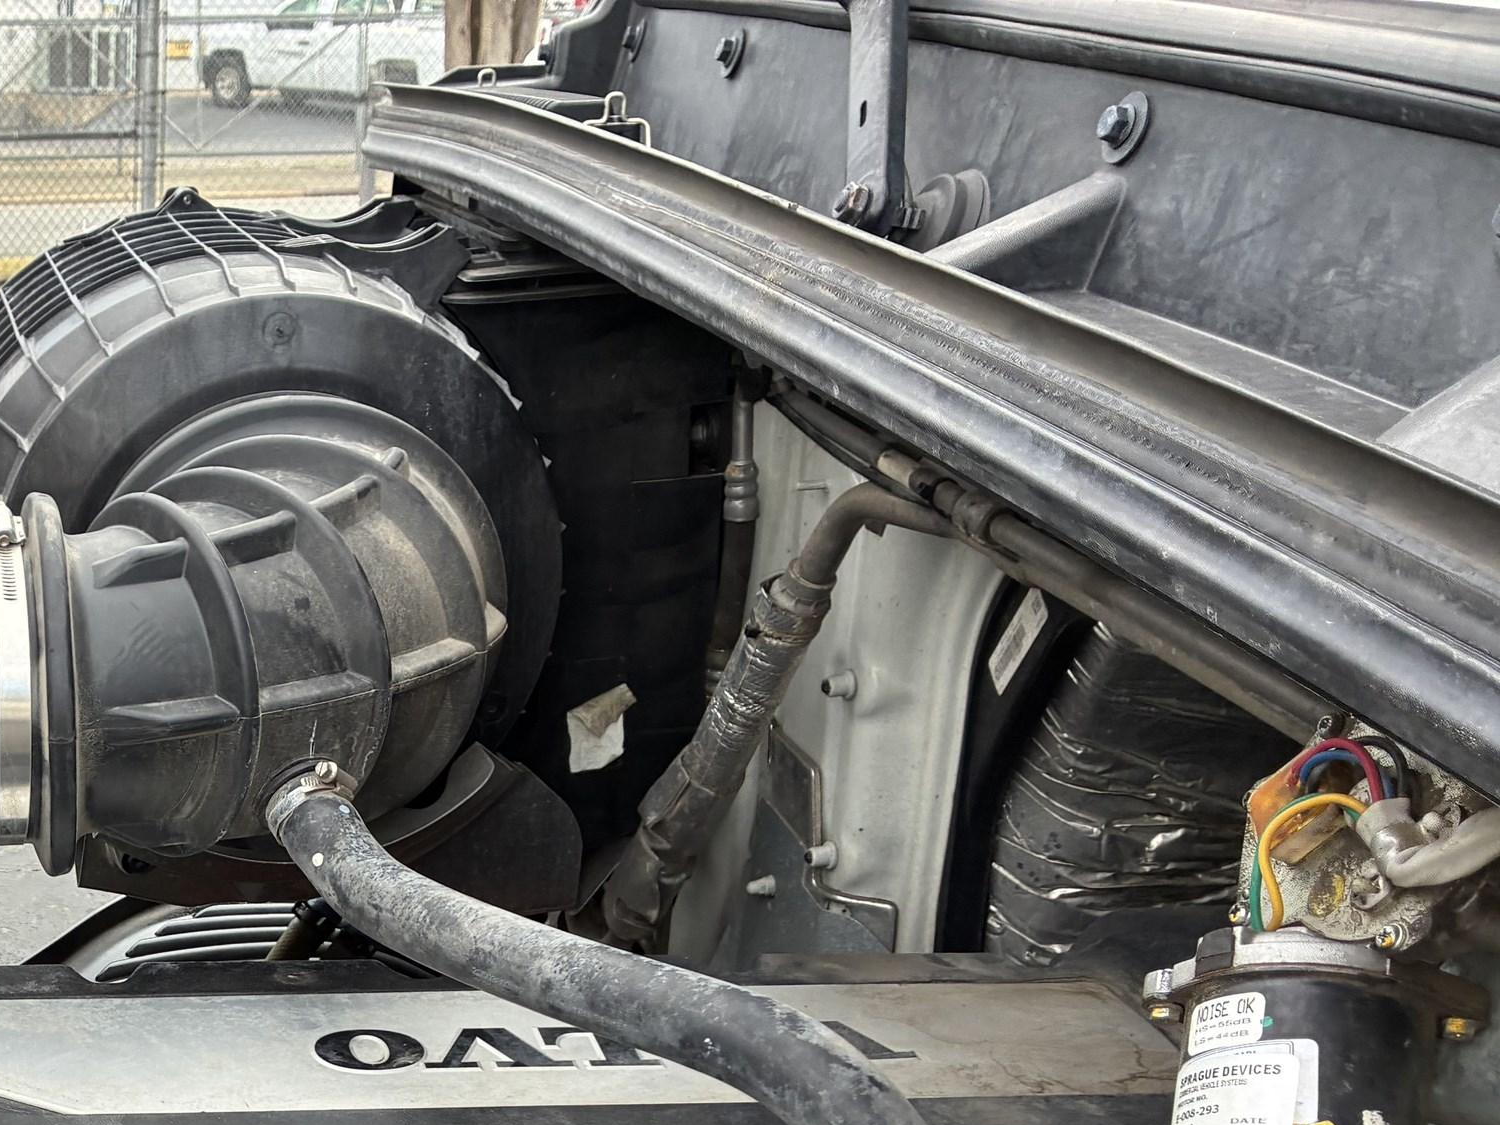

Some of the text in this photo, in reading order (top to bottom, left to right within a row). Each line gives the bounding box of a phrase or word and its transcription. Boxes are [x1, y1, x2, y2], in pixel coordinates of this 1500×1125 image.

[1197, 997, 1255, 1024] NOISE OK
[1180, 1064, 1282, 1089] SPRAGUE DEVICES
